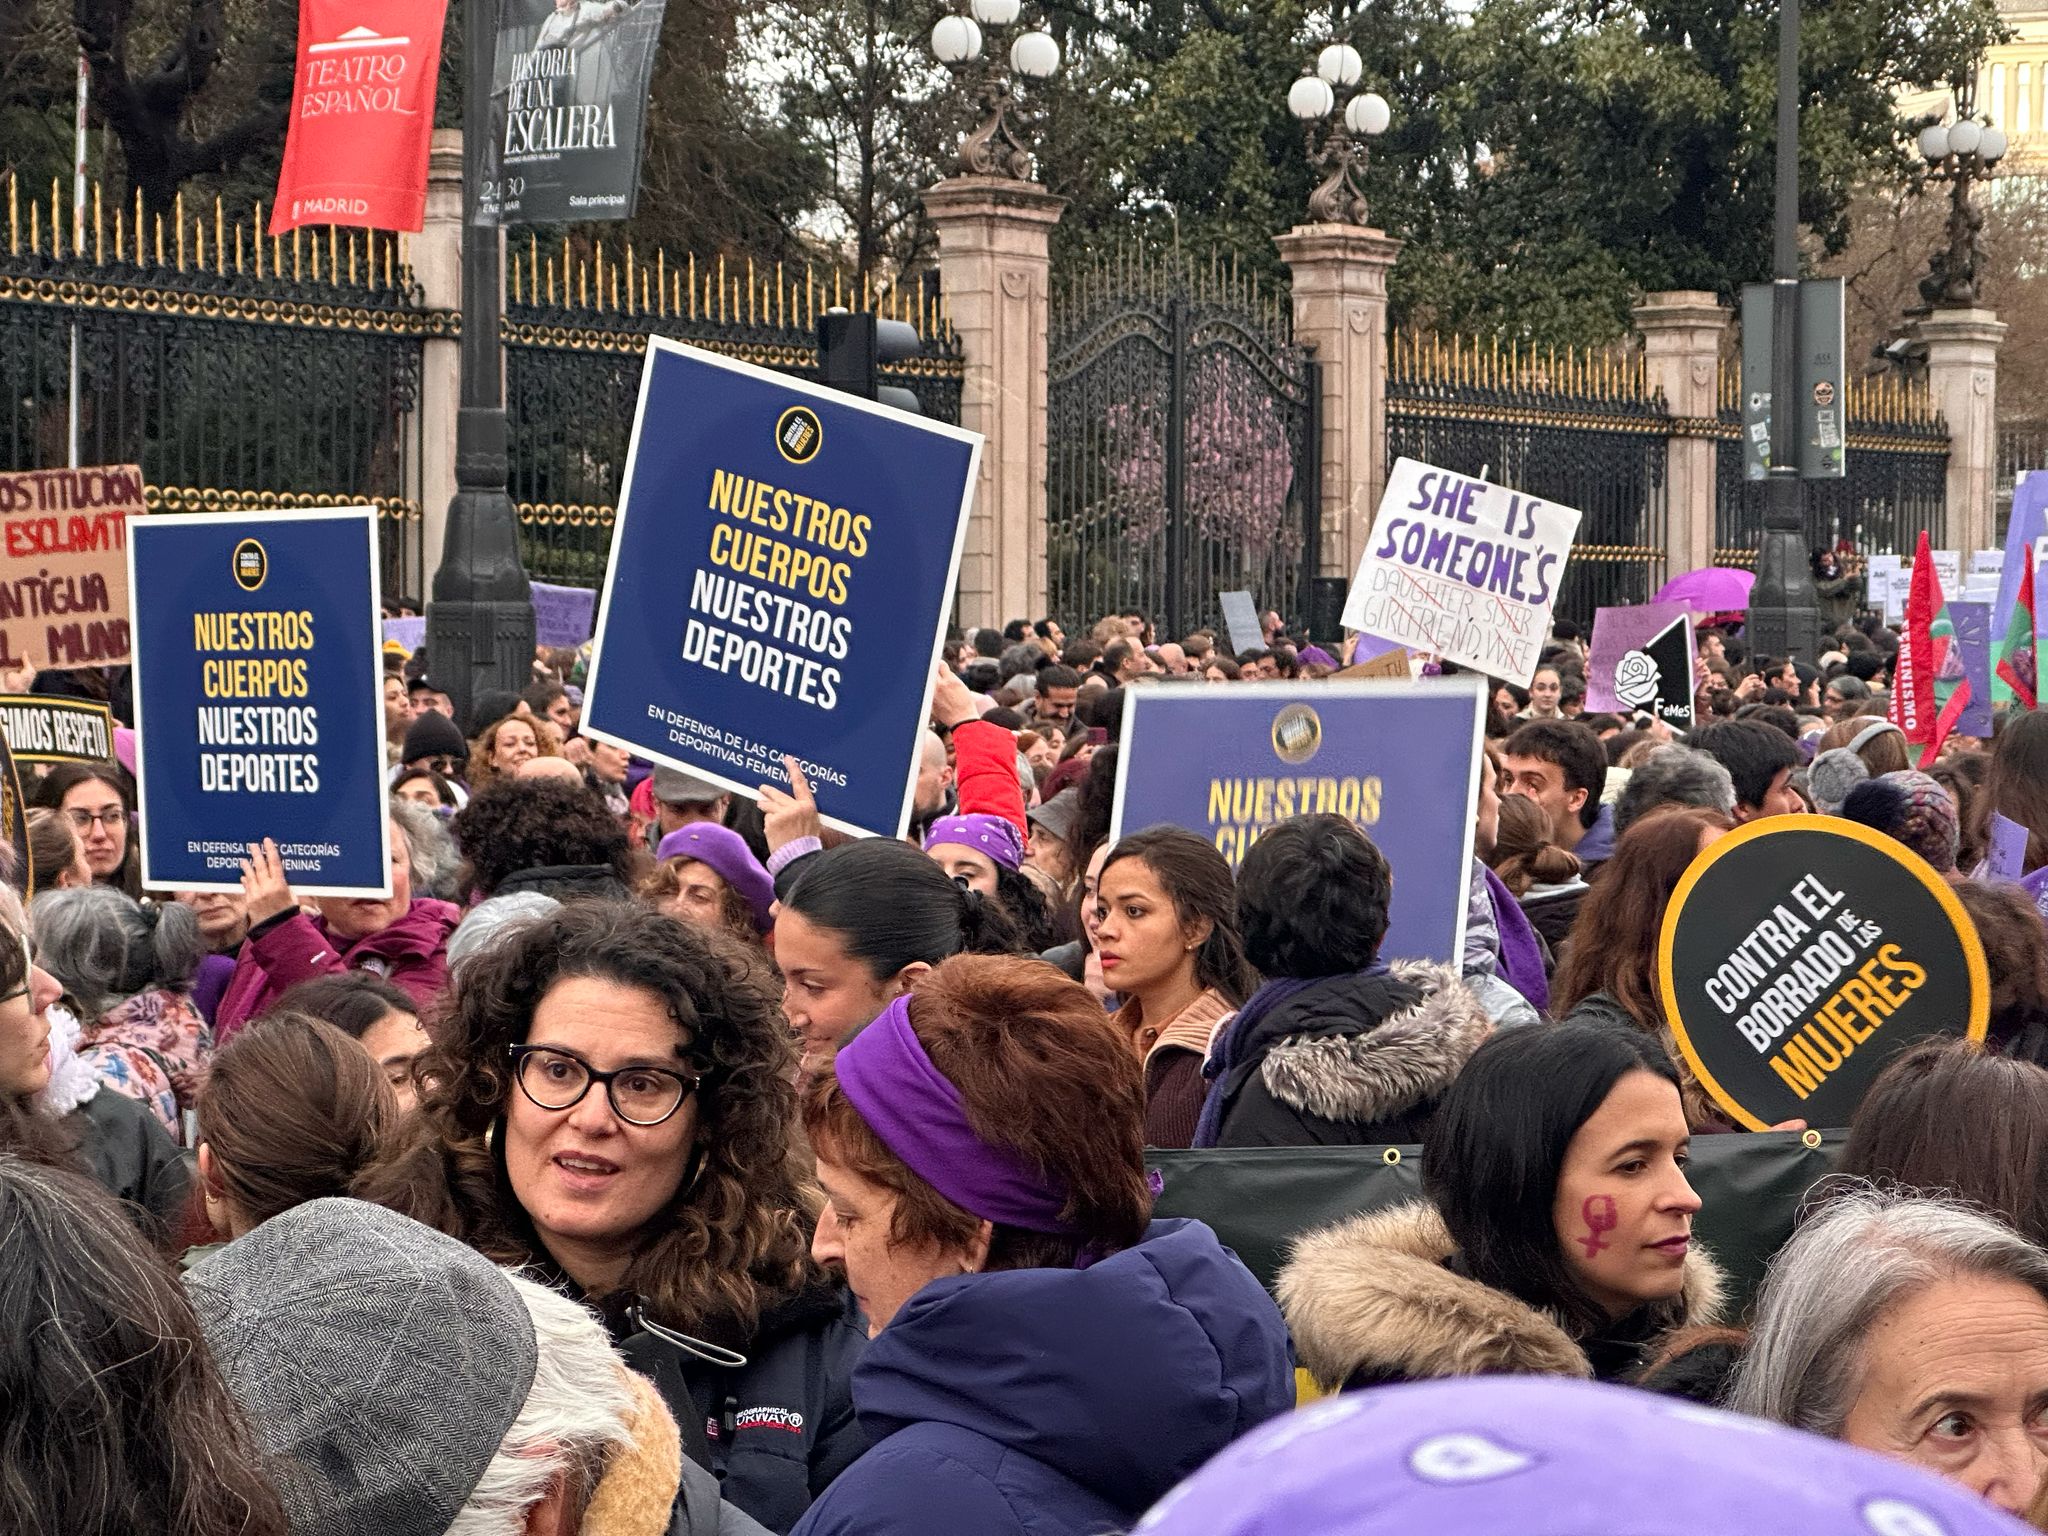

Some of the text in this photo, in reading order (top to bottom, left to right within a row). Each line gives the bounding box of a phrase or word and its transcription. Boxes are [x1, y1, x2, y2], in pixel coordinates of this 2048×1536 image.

[306, 54, 406, 88] TEATRO
[510, 48, 577, 82] HISTORIA
[301, 85, 417, 118] ESPAÑOL
[507, 79, 555, 112] DE UNA
[504, 103, 617, 155] ESCALERA
[303, 198, 369, 216] MADRID
[506, 176, 525, 197] 30
[569, 194, 626, 207] Sala principal
[708, 468, 872, 559] NUESTROS
[1408, 472, 1541, 540] SHE IS
[709, 523, 852, 606] CUERPOS
[1376, 518, 1557, 605] SOMEONE'S
[194, 610, 314, 652] NUESTROS
[690, 569, 853, 660] NUESTROS
[1483, 598, 1533, 636] SISTER
[47, 617, 131, 664] MUND
[682, 618, 843, 710] DEPORTES
[1486, 628, 1534, 676] WIFE
[203, 658, 309, 698] CUERPOS
[52, 709, 108, 759] RESPETO
[197, 706, 318, 746] NUESTROS
[648, 704, 847, 787] EN DEFENSA DE LAS CAGORÍAS
[201, 753, 319, 794] DEPORTES
[669, 729, 818, 794] DEPORTIVAS FEMENS
[1208, 775, 1382, 825] NUESTROS
[188, 841, 200, 853] EN
[202, 842, 244, 854] DEFENSA
[280, 842, 340, 857] CATEGORÍAS
[1704, 873, 1846, 1014] CONTRA EL
[1735, 908, 1883, 1054] BORRADO DE LAS
[1768, 943, 1928, 1100] MUJERES
